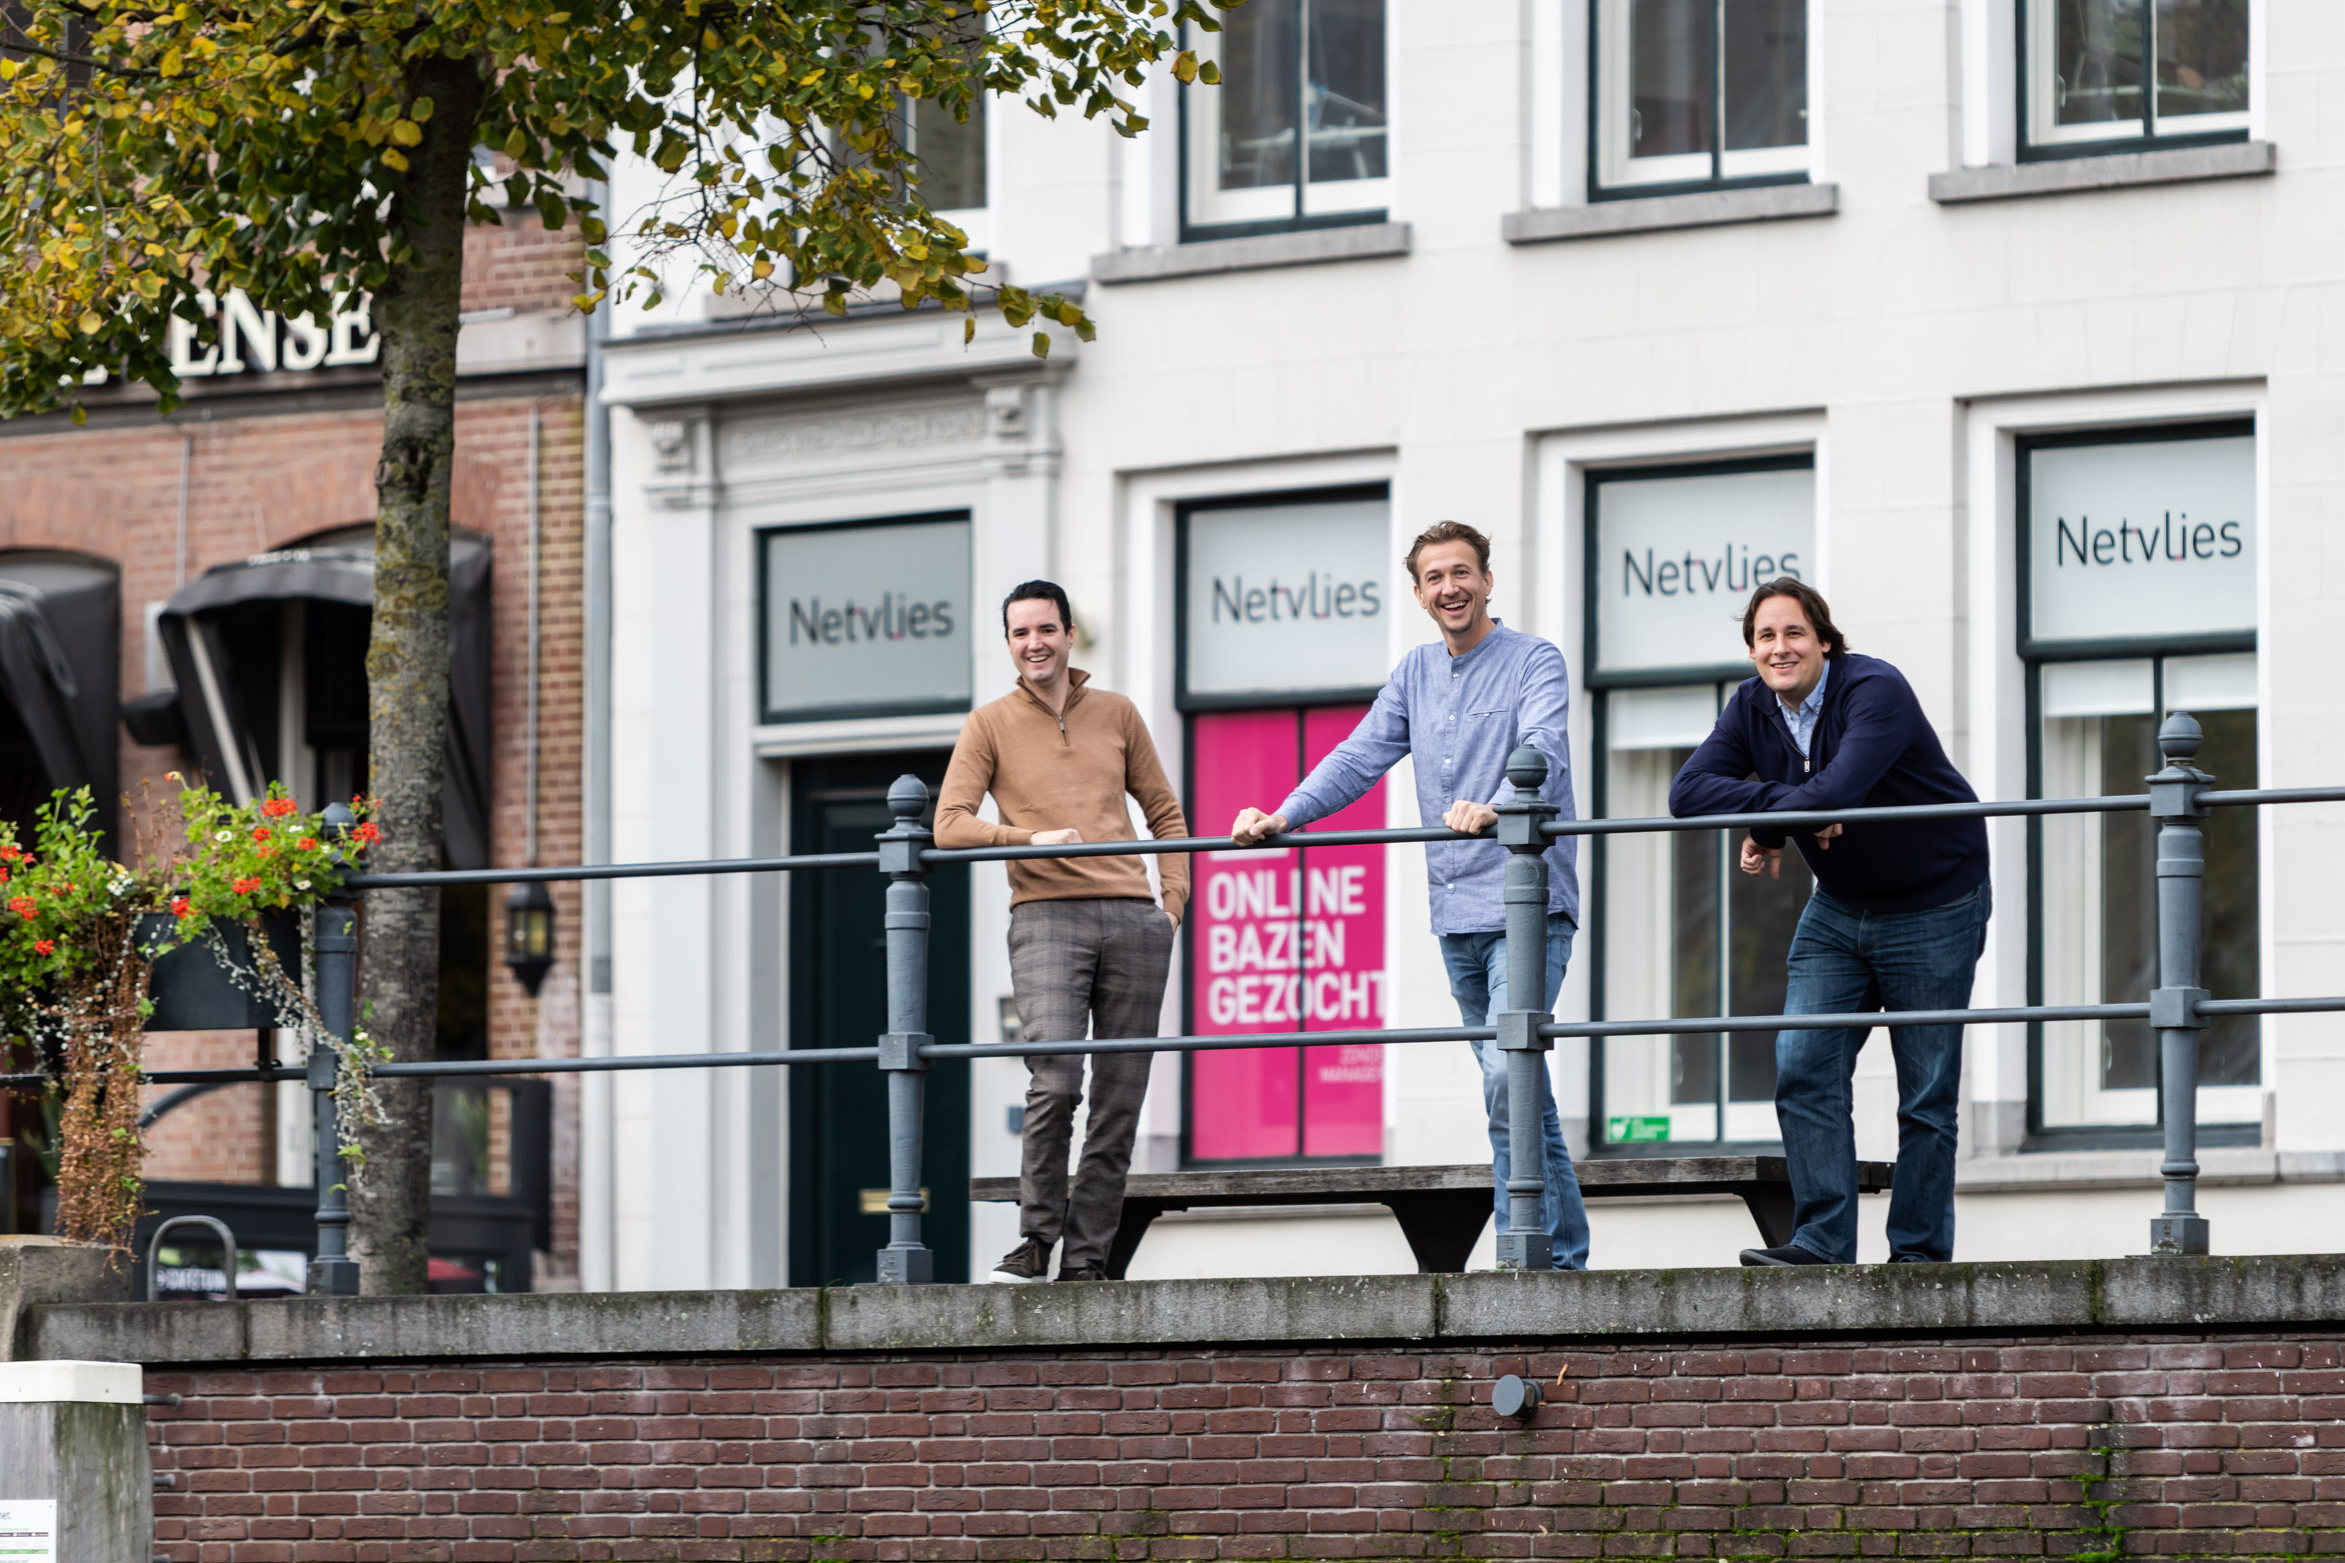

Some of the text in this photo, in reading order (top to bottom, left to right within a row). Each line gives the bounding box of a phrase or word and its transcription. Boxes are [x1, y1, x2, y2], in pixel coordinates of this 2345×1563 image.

[2058, 509, 2243, 567] Netvlies
[1213, 570, 1381, 624] Netvlies
[1624, 542, 1801, 597] Netvlies
[789, 591, 955, 647] Netvlies
[1207, 865, 1366, 921] ONLINE
[1208, 919, 1345, 973] BAZEN
